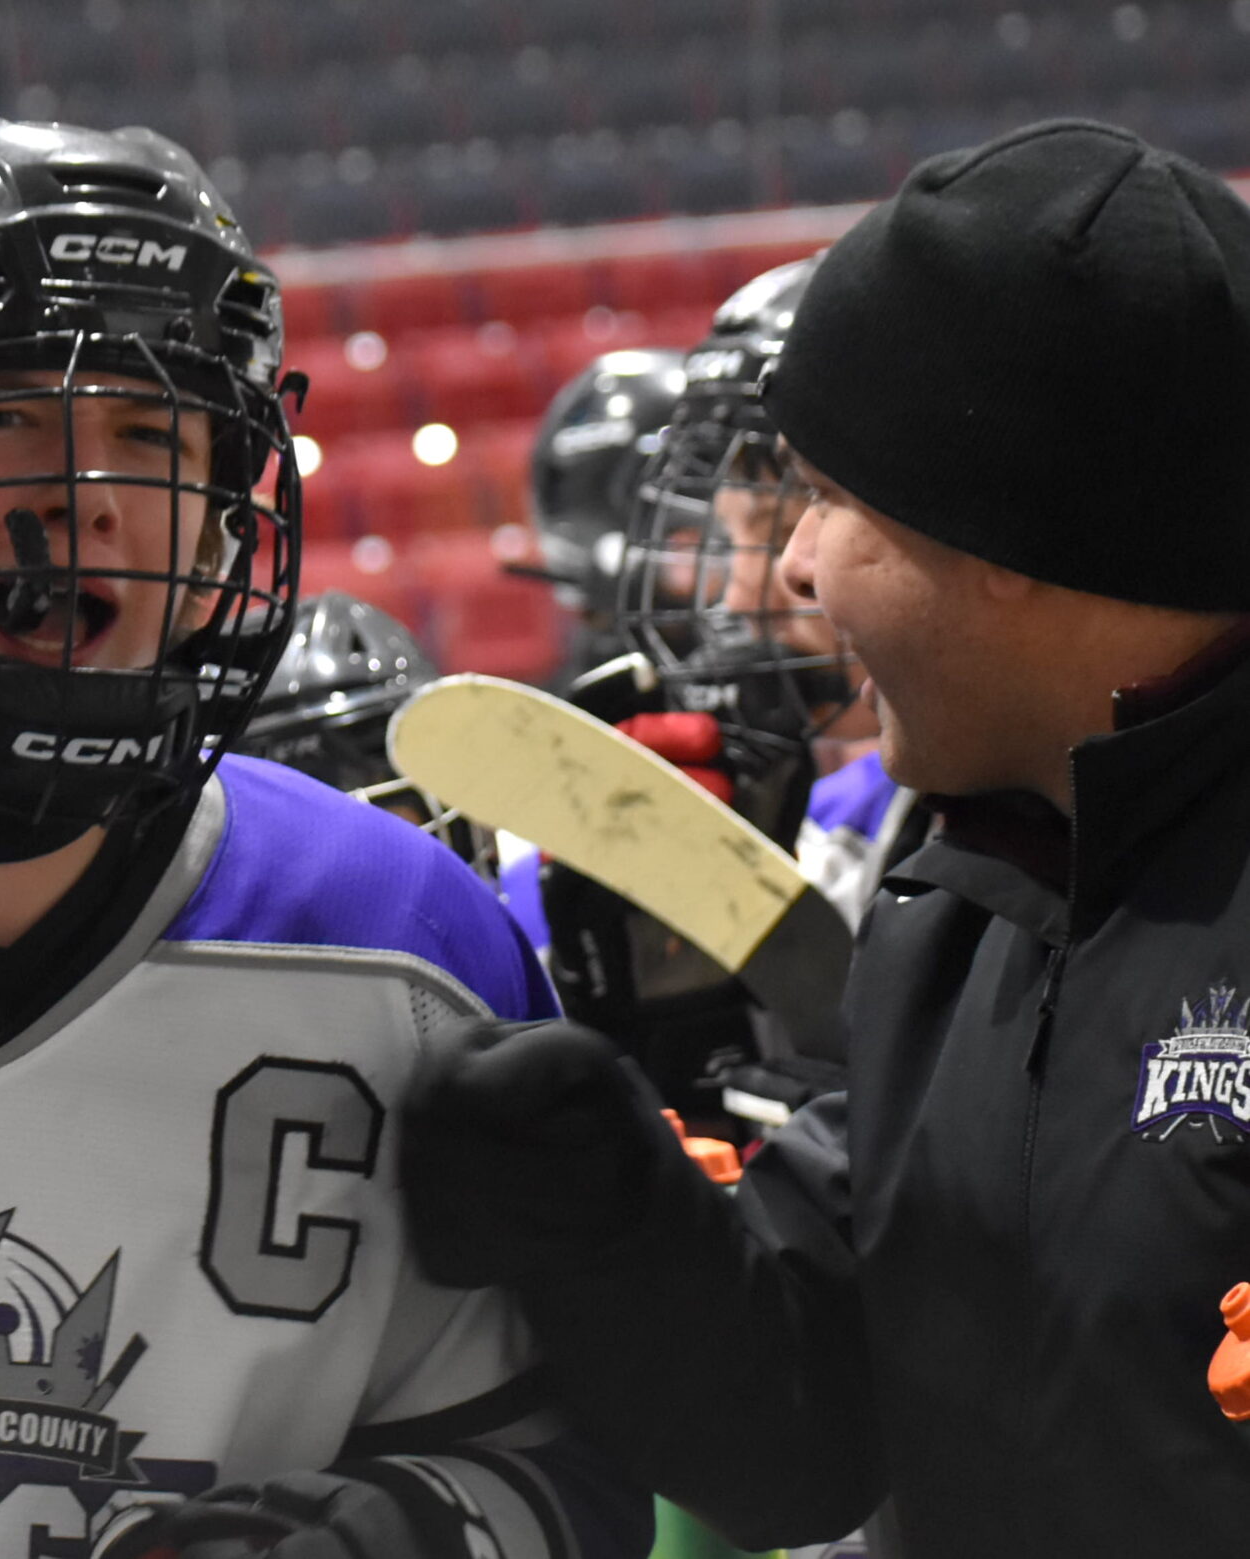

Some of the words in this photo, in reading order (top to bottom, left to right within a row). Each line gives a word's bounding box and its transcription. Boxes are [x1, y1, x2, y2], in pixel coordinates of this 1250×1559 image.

[50, 234, 188, 272] CCM
[1137, 1058, 1250, 1123] KINGS
[199, 1054, 386, 1324] C
